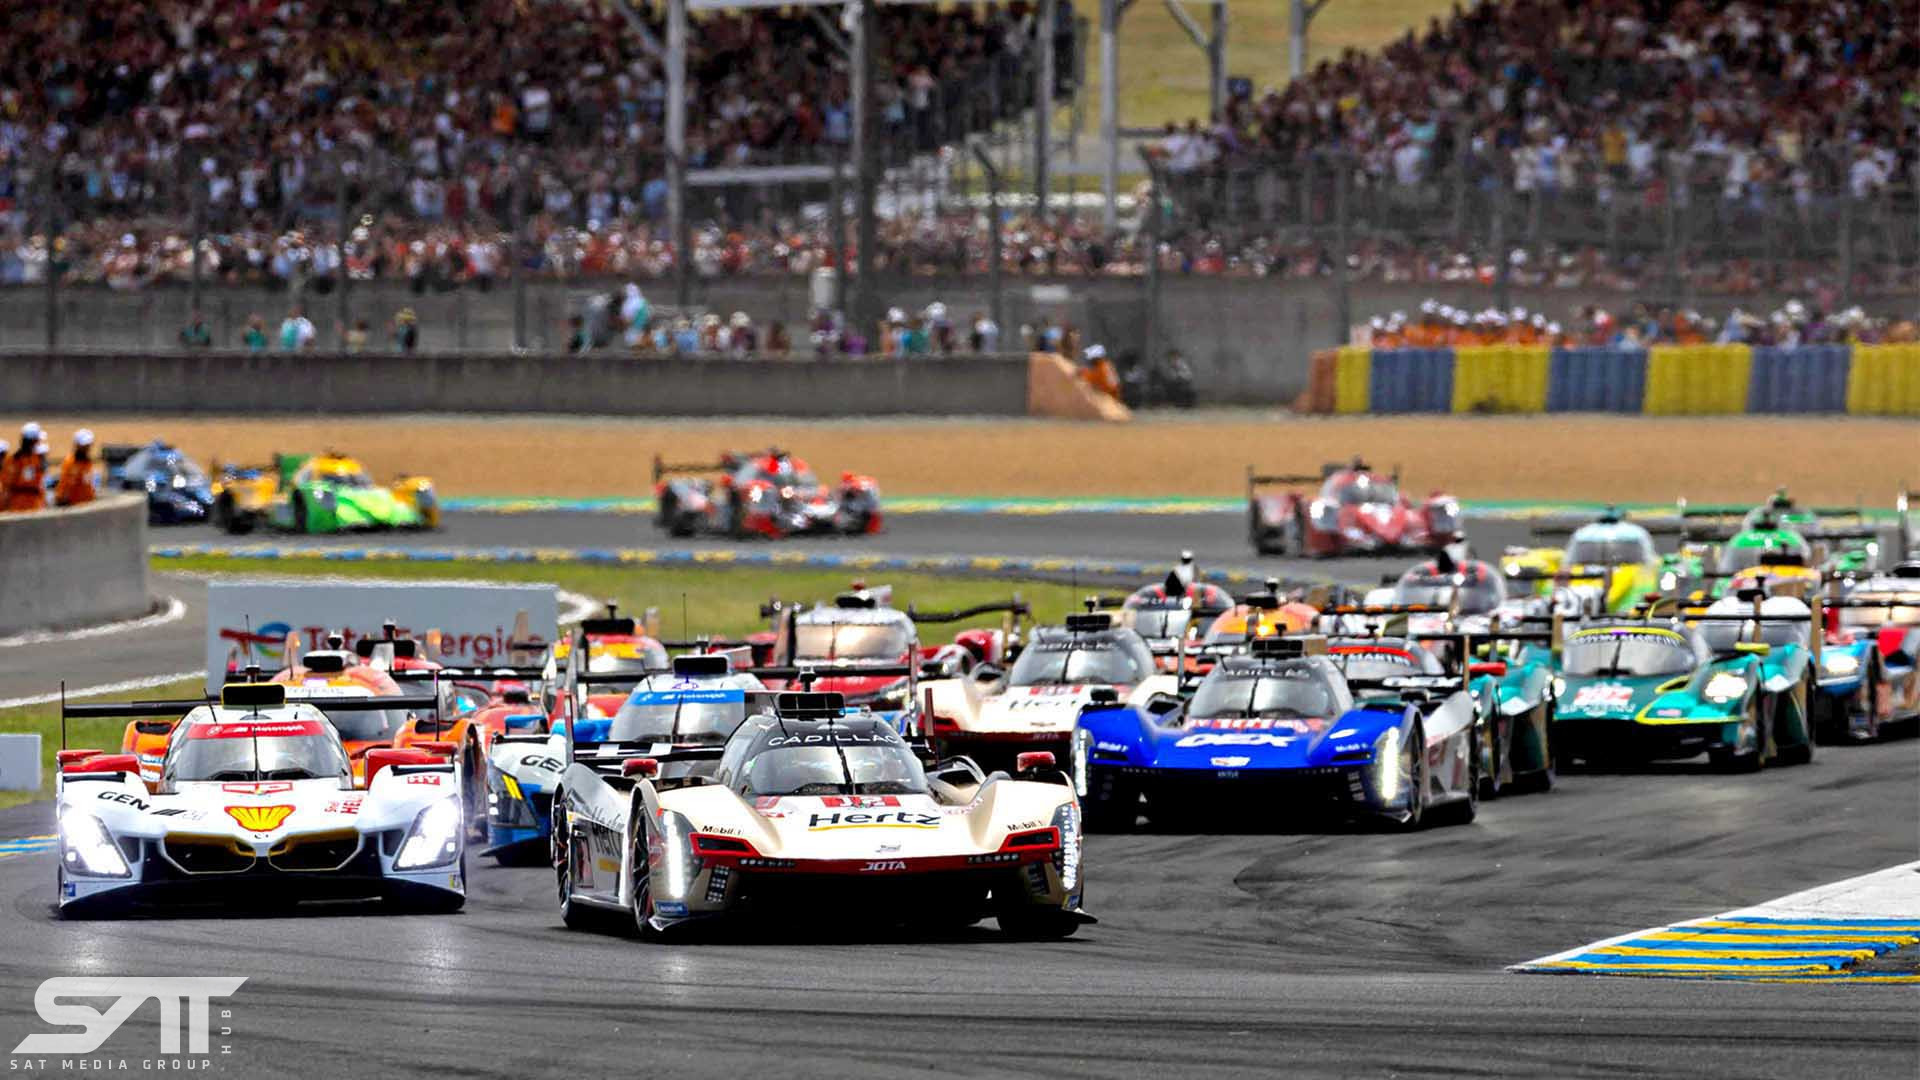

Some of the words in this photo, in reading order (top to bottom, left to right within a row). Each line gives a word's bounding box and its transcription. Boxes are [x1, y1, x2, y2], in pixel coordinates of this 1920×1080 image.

[768, 733, 899, 747] CADILLAC
[520, 754, 566, 775] GE
[98, 790, 150, 811] GEN
[809, 811, 941, 827] Hertz
[702, 825, 734, 835] Mobil
[858, 861, 907, 871] JOTA
